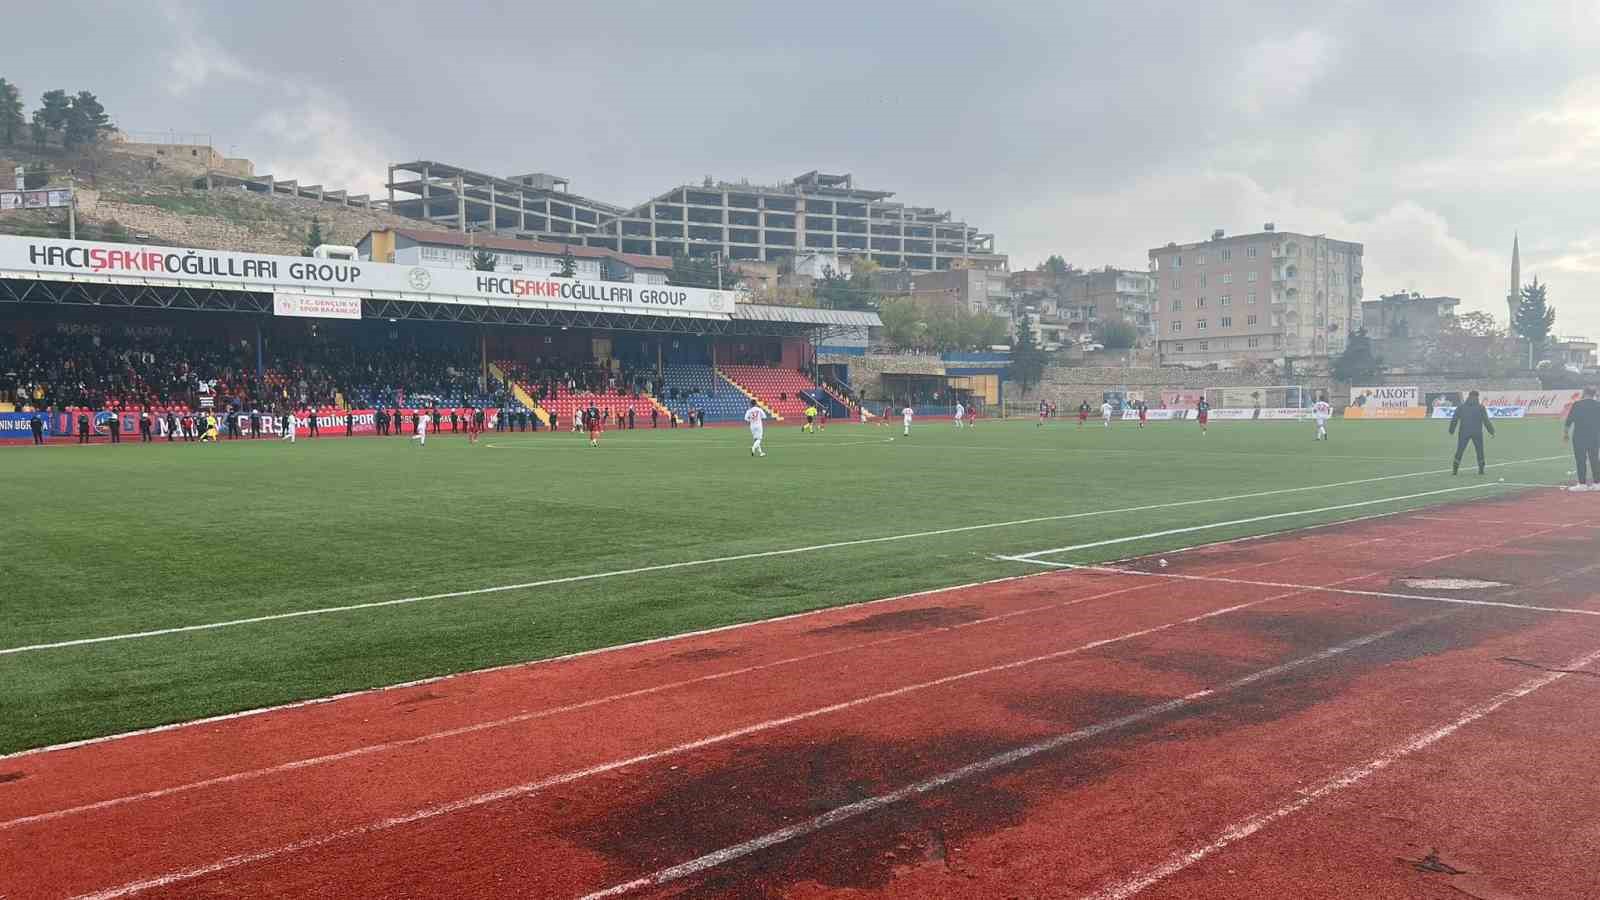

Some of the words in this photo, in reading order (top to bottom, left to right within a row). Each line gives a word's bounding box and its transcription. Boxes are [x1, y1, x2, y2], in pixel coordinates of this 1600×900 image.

[29, 244, 278, 280] HACIŞAKİROĞULLARI
[289, 262, 361, 283] GROUP
[639, 289, 687, 306] GROUP
[1374, 388, 1417, 399] JAKOFT
[296, 413, 374, 428] MRDİNSPOR
